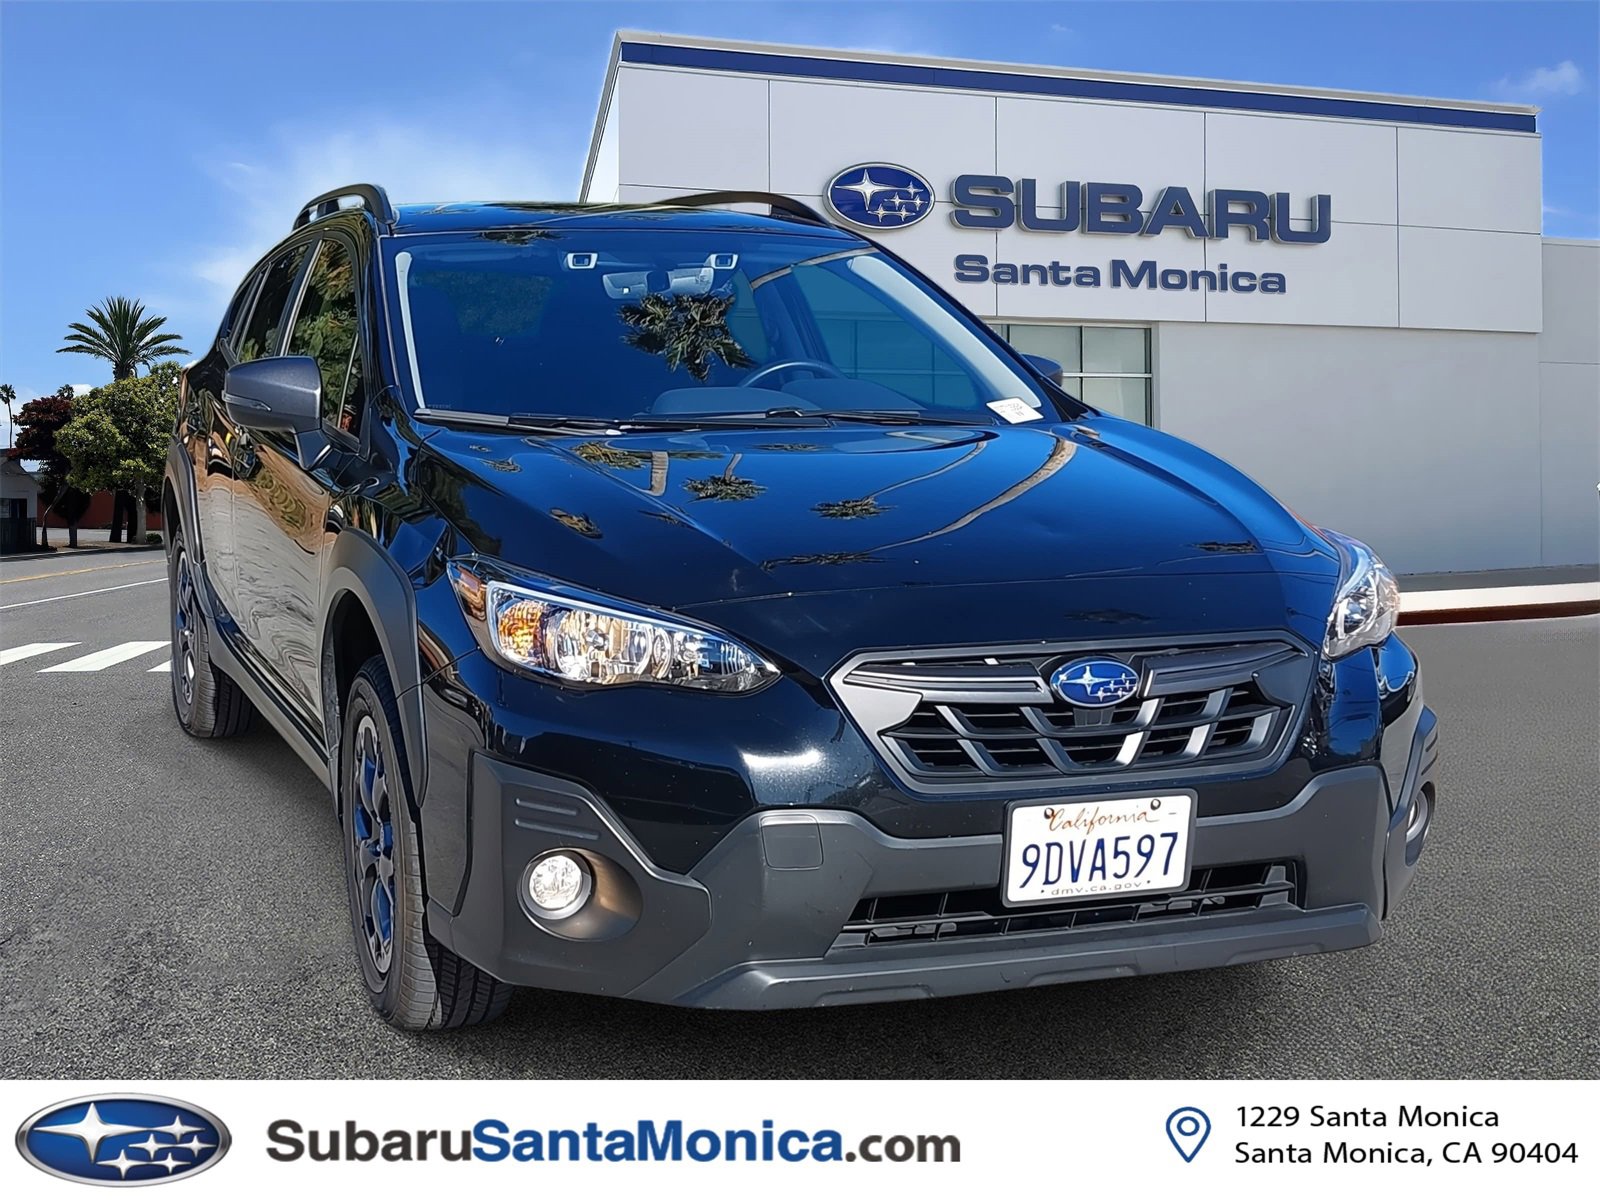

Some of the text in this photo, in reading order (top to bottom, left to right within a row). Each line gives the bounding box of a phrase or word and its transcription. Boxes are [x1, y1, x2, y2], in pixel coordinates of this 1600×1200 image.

[951, 174, 1331, 244] SUBARU
[954, 254, 1286, 294] Santa Monica
[1049, 807, 1160, 835] California
[1019, 832, 1178, 889] 9DVA597
[1051, 881, 1142, 896] dmv.ca.gov
